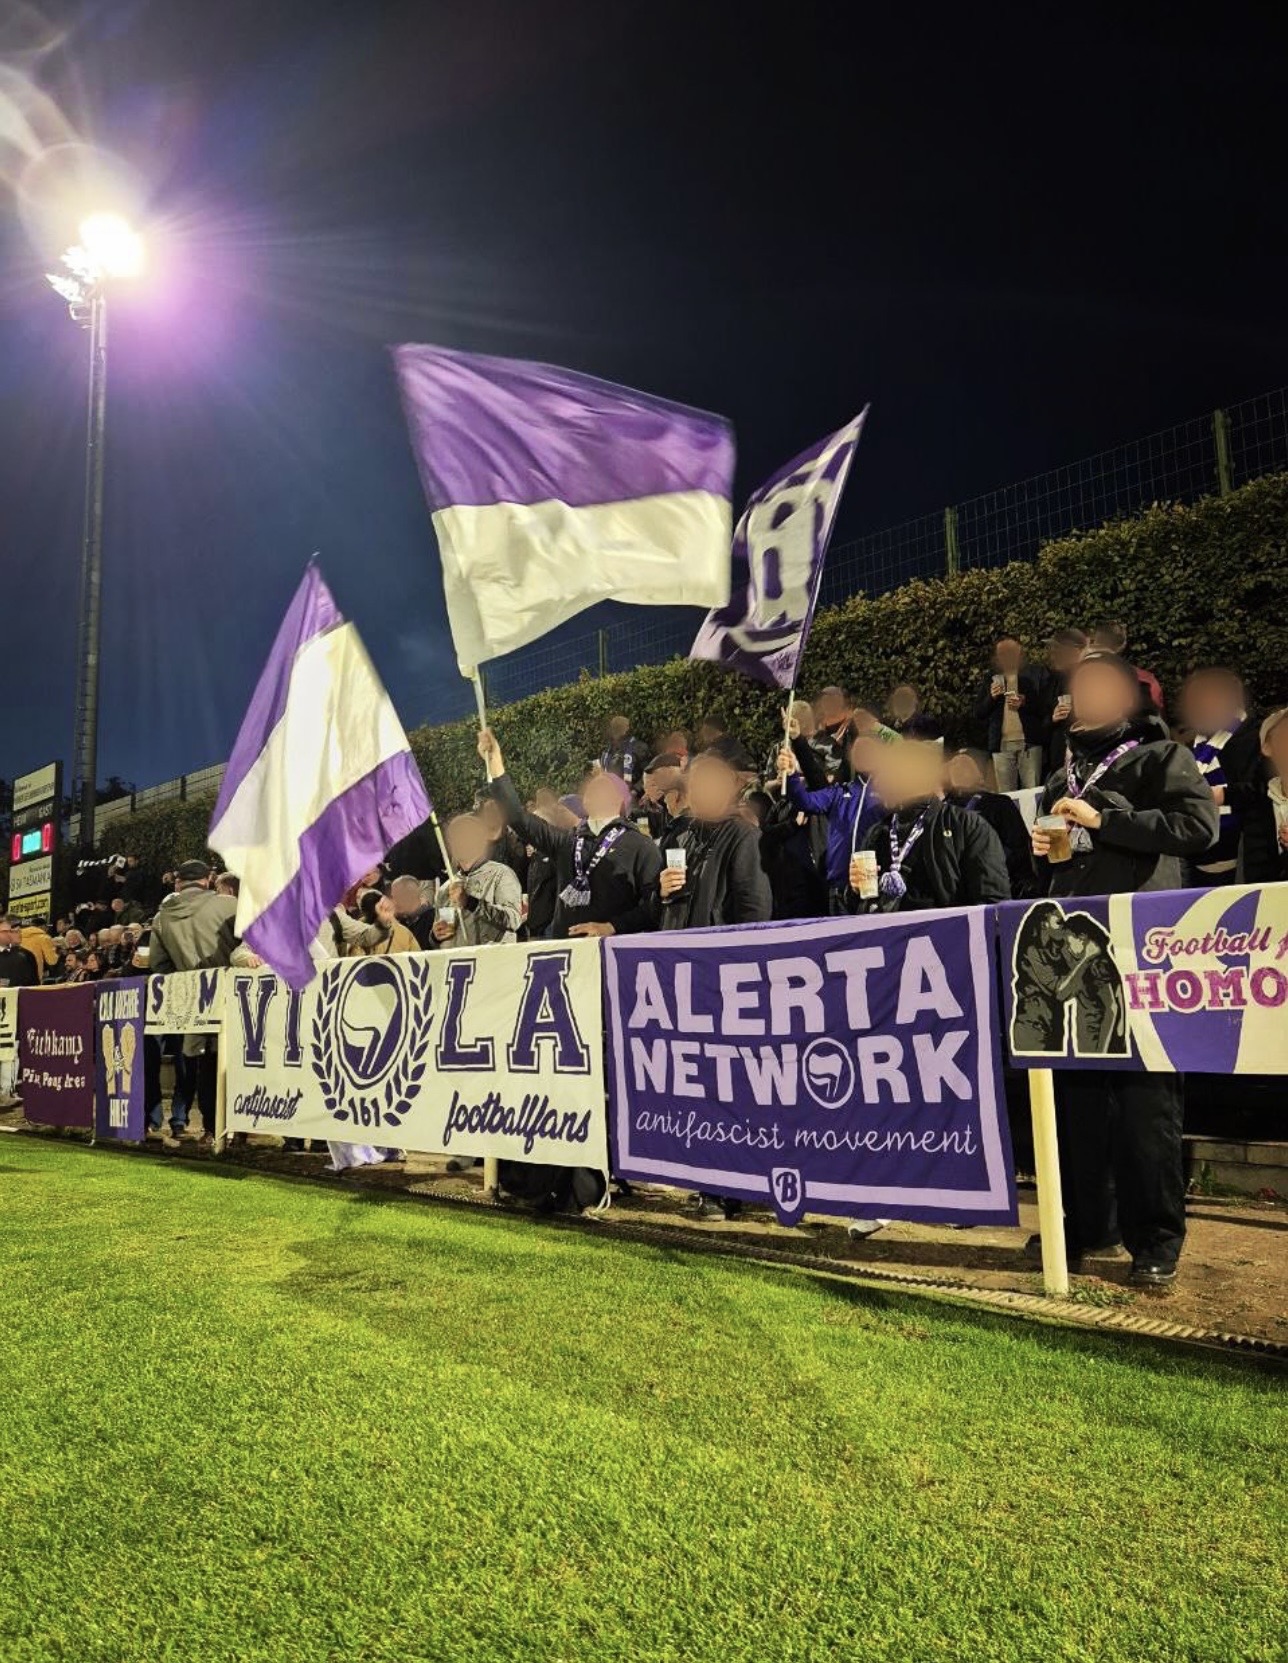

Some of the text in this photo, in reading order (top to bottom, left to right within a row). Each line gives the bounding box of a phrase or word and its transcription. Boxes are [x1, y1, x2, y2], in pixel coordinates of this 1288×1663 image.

[1146, 926, 1272, 960] Football
[628, 935, 964, 1036] ALERTA
[1125, 966, 1288, 1010] HOMO
[631, 1030, 973, 1109] NETWORK
[233, 1084, 303, 1127] antifascist
[349, 1096, 381, 1128] 161
[443, 1090, 592, 1155] footballfans
[635, 1110, 977, 1155] antifascist movement
